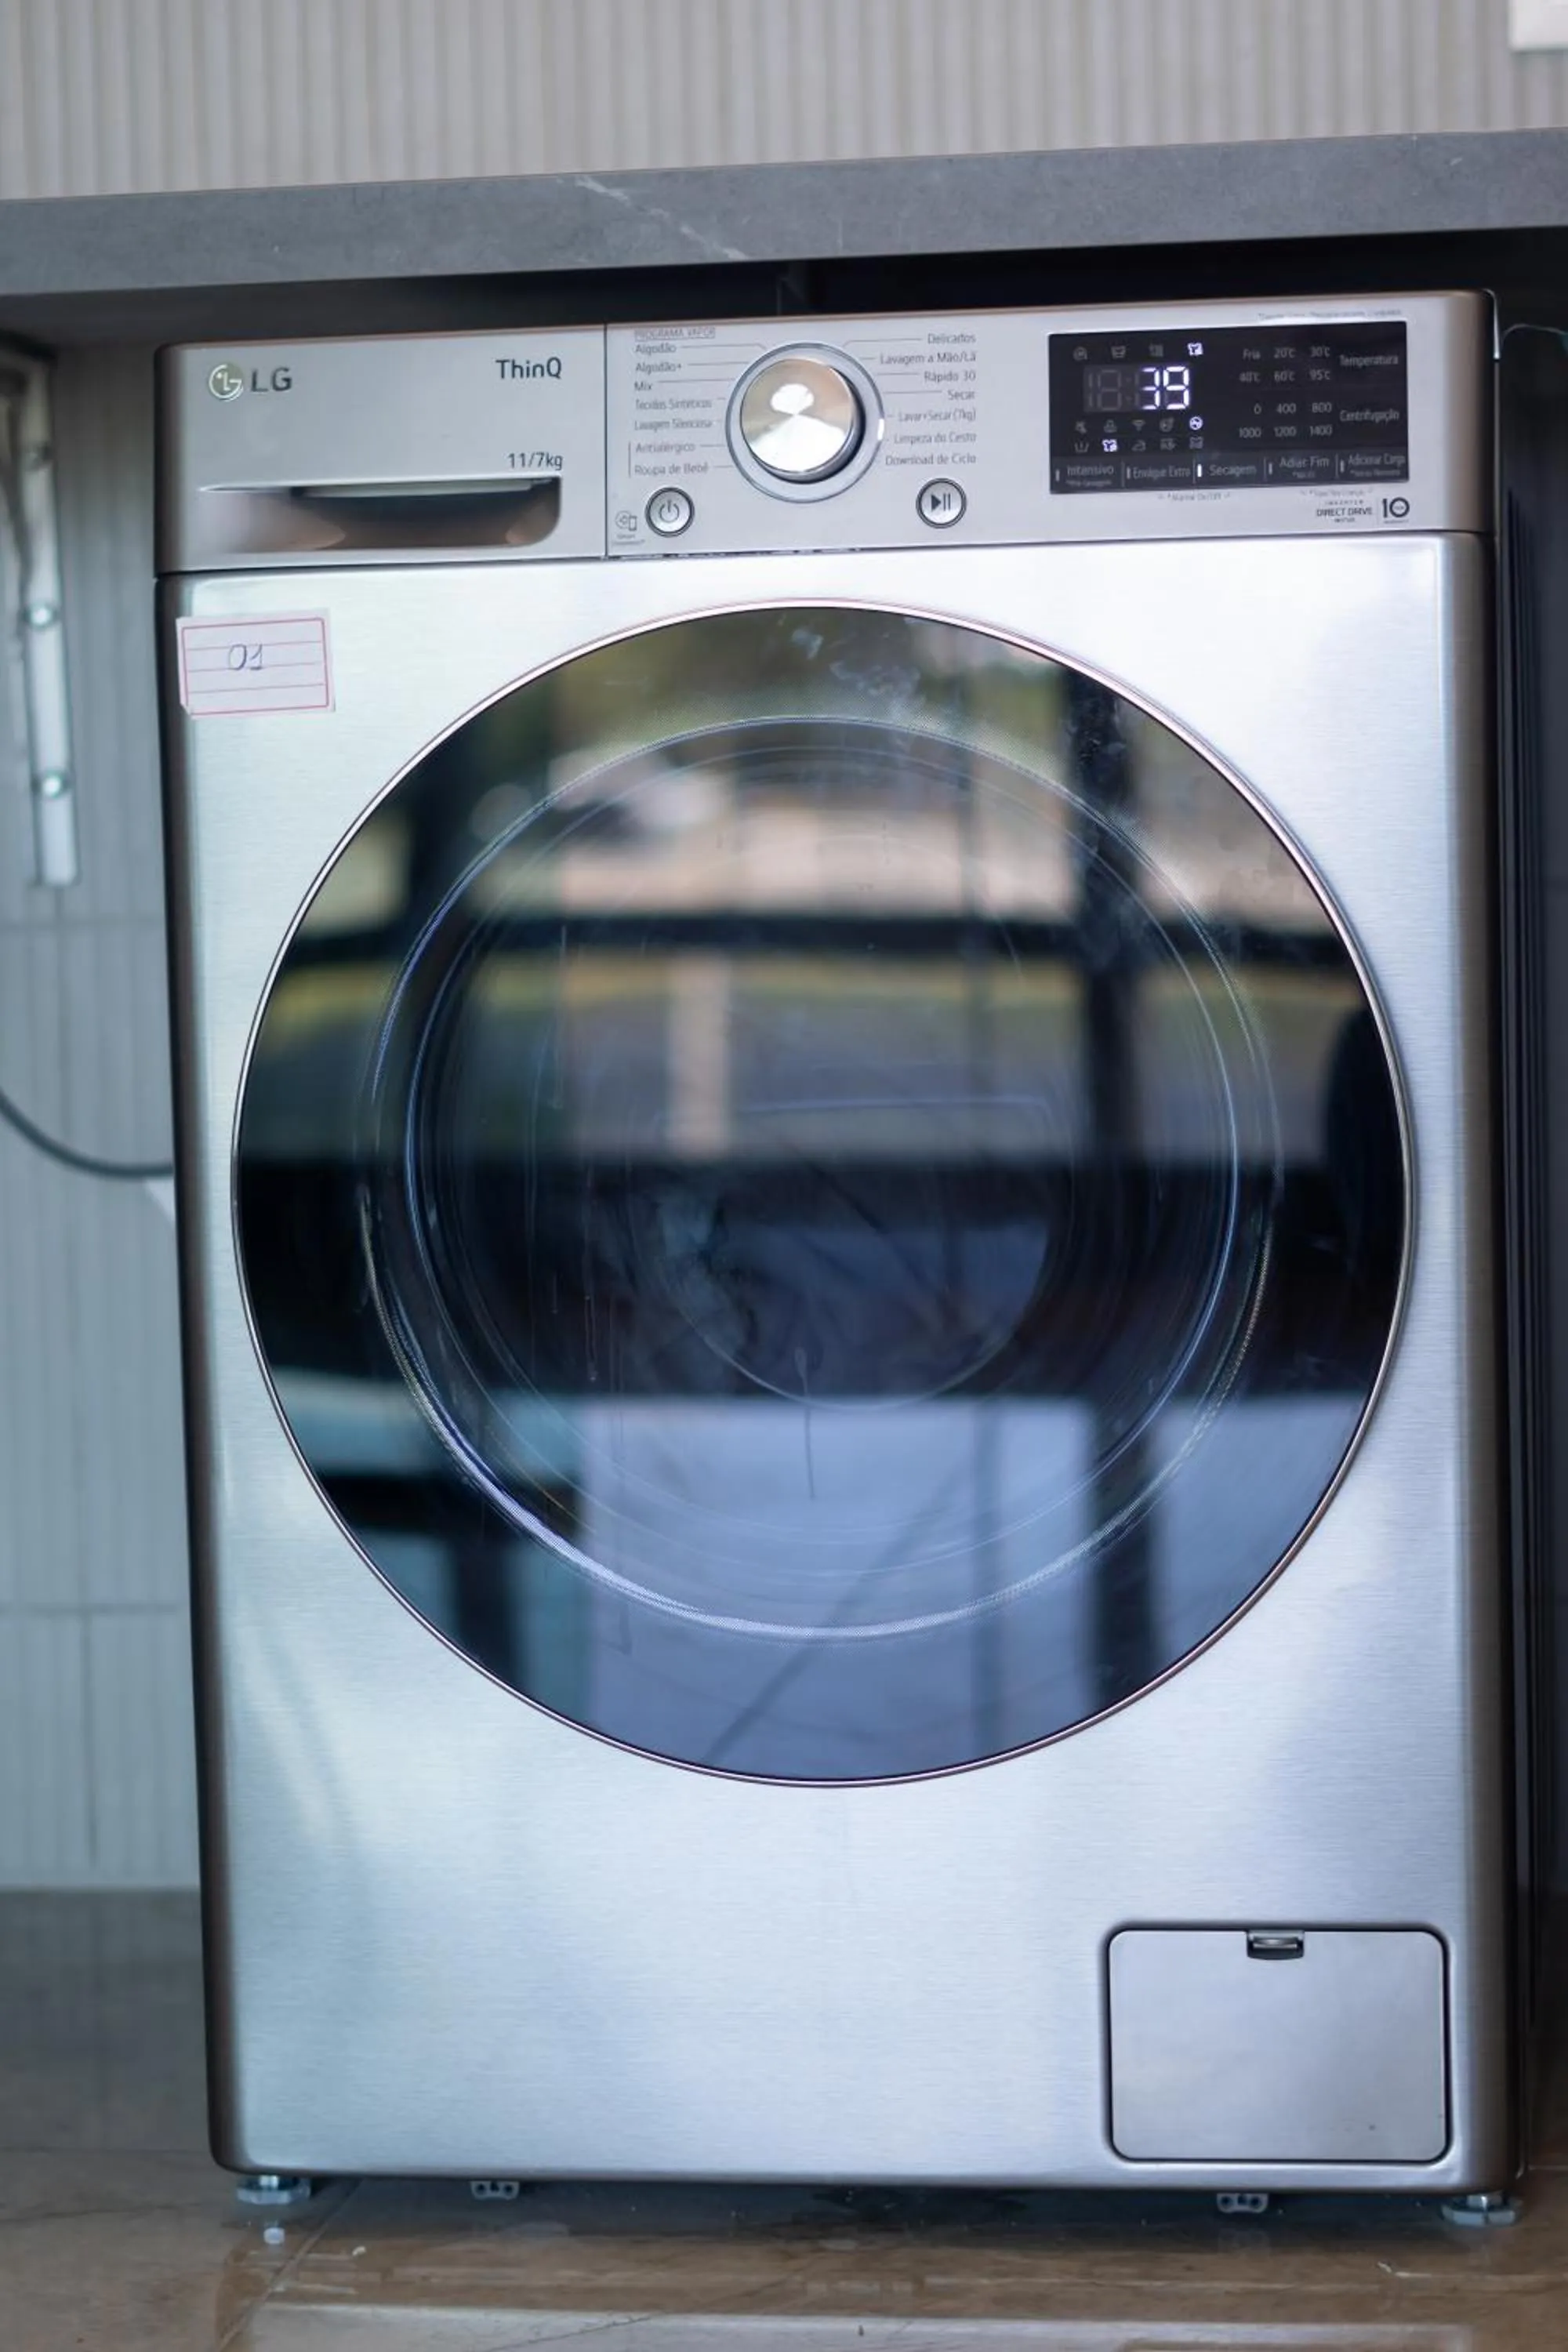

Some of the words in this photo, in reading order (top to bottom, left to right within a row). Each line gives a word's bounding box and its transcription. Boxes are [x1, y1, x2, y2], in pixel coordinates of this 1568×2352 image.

[927, 332, 977, 344] Delicados
[880, 354, 925, 365] Lavagem
[1339, 354, 1399, 368] Temperatura
[495, 357, 562, 381] ThinQ
[252, 367, 292, 393] LG
[963, 370, 977, 382] 30
[634, 381, 653, 392] Mix
[947, 389, 976, 401] Secar
[1276, 403, 1297, 414] 400
[508, 452, 563, 471] 11/7kg
[1209, 464, 1258, 479] Secagem
